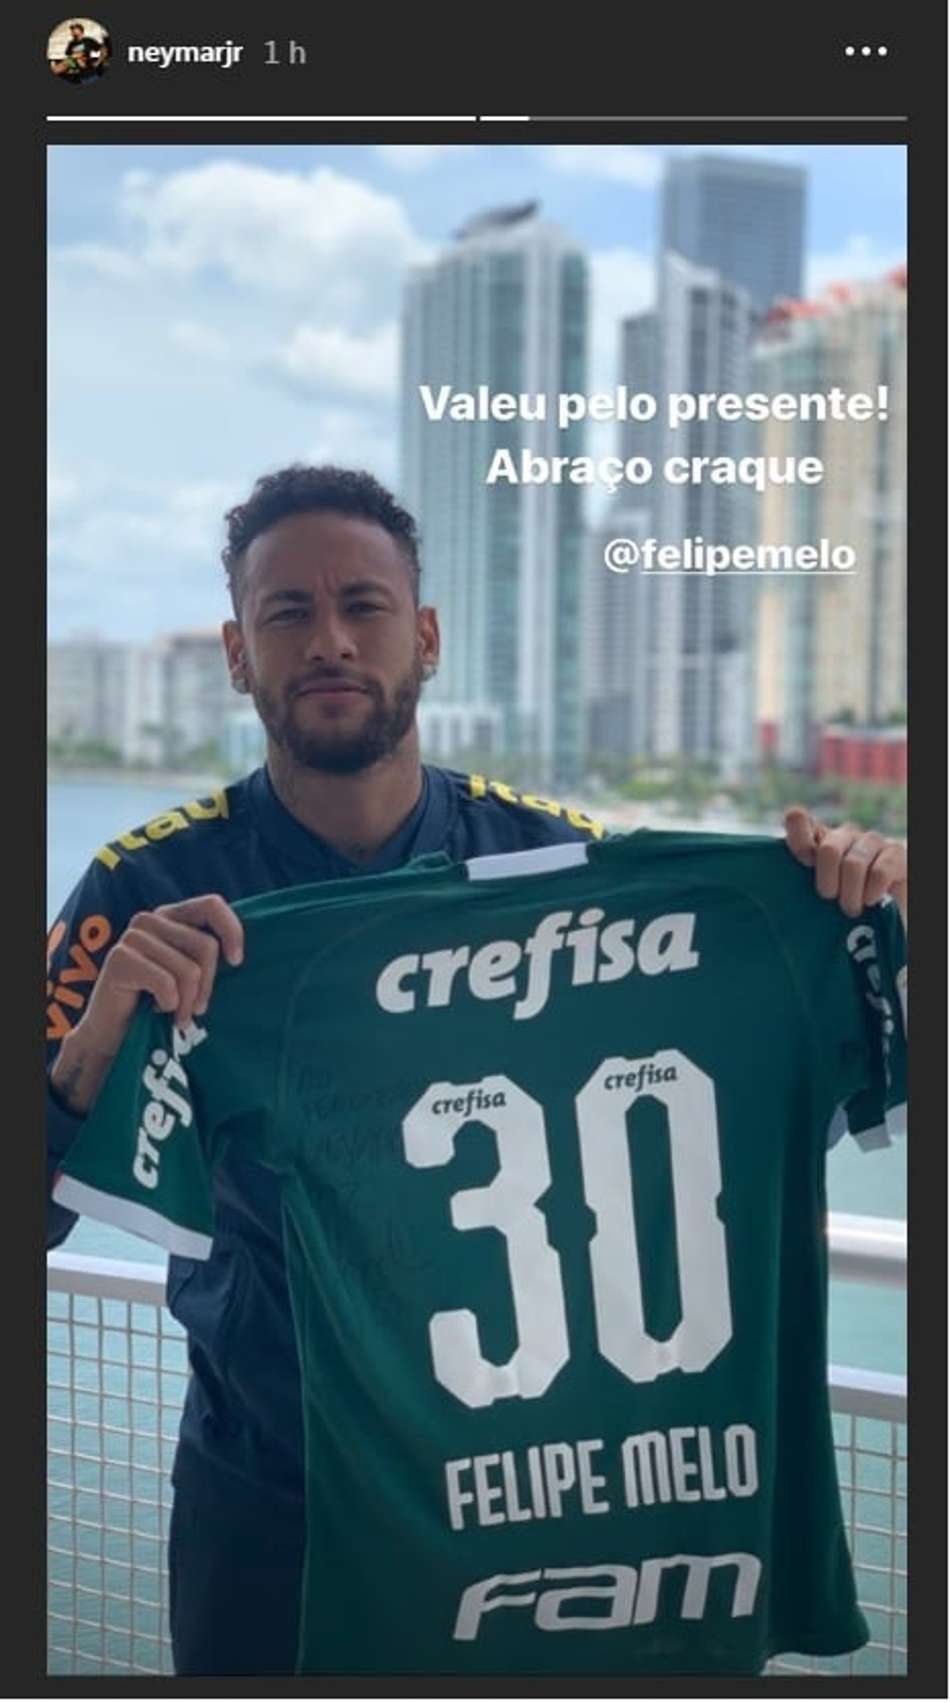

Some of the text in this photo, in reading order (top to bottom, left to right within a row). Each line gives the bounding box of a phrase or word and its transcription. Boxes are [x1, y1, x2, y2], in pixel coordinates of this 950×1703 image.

[376, 909, 699, 1020] crefisa
[432, 1089, 506, 1117] crefisa
[603, 1063, 678, 1092] crefisa
[402, 1048, 733, 1409] 30
[445, 1424, 759, 1531] FELIPE MELO
